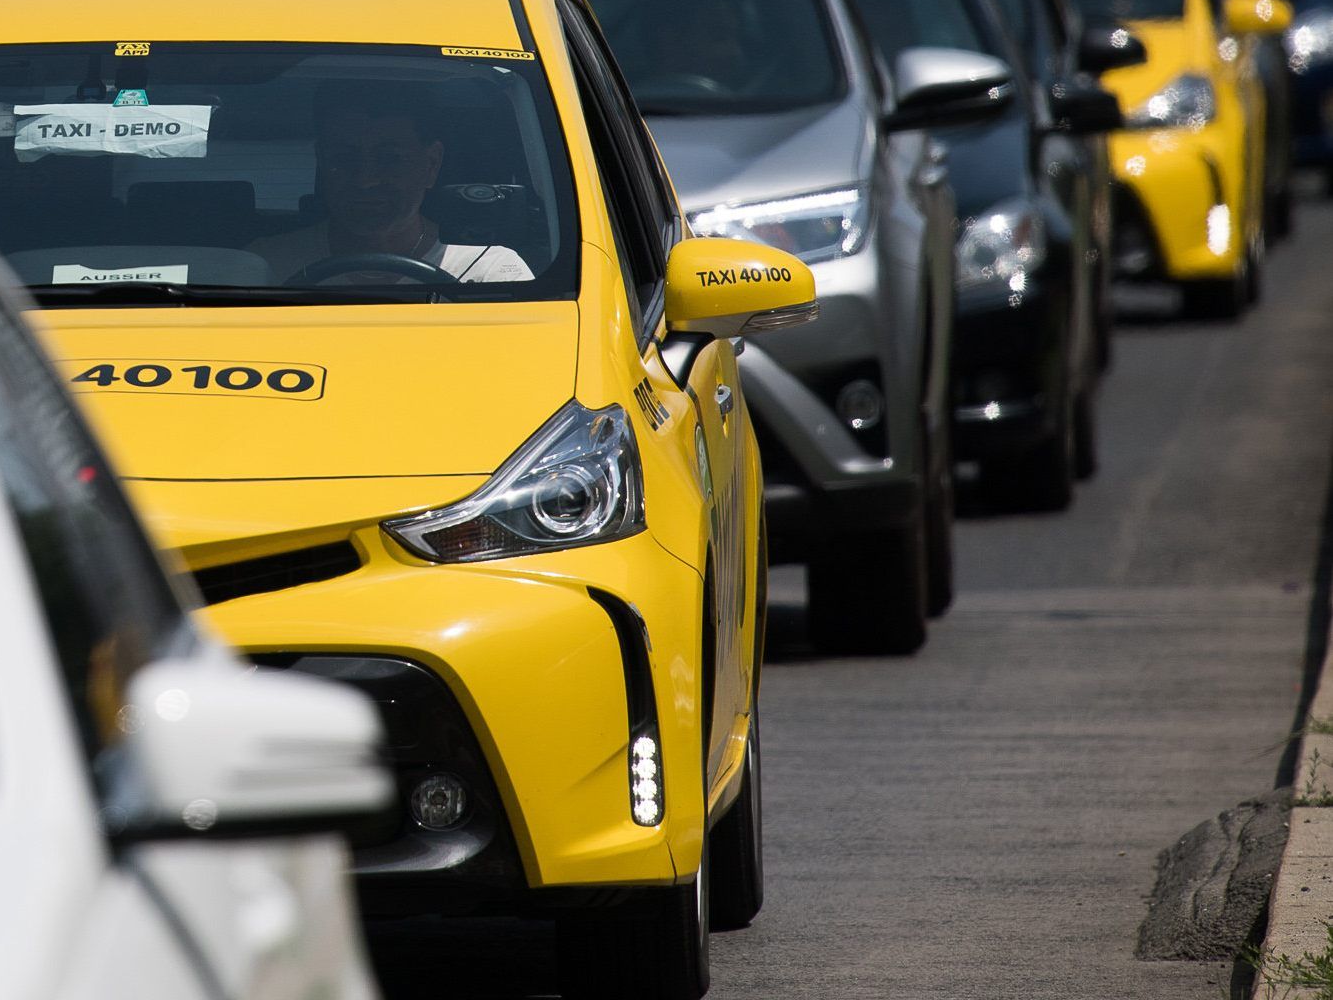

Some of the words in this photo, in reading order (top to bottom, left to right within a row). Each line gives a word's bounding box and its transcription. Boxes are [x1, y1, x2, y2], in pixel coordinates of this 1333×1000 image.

[445, 48, 479, 56] TAXI
[38, 123, 91, 138] TAXI
[114, 122, 181, 137] DEMO
[80, 272, 162, 282] AUSSER
[696, 268, 736, 288] TAXI
